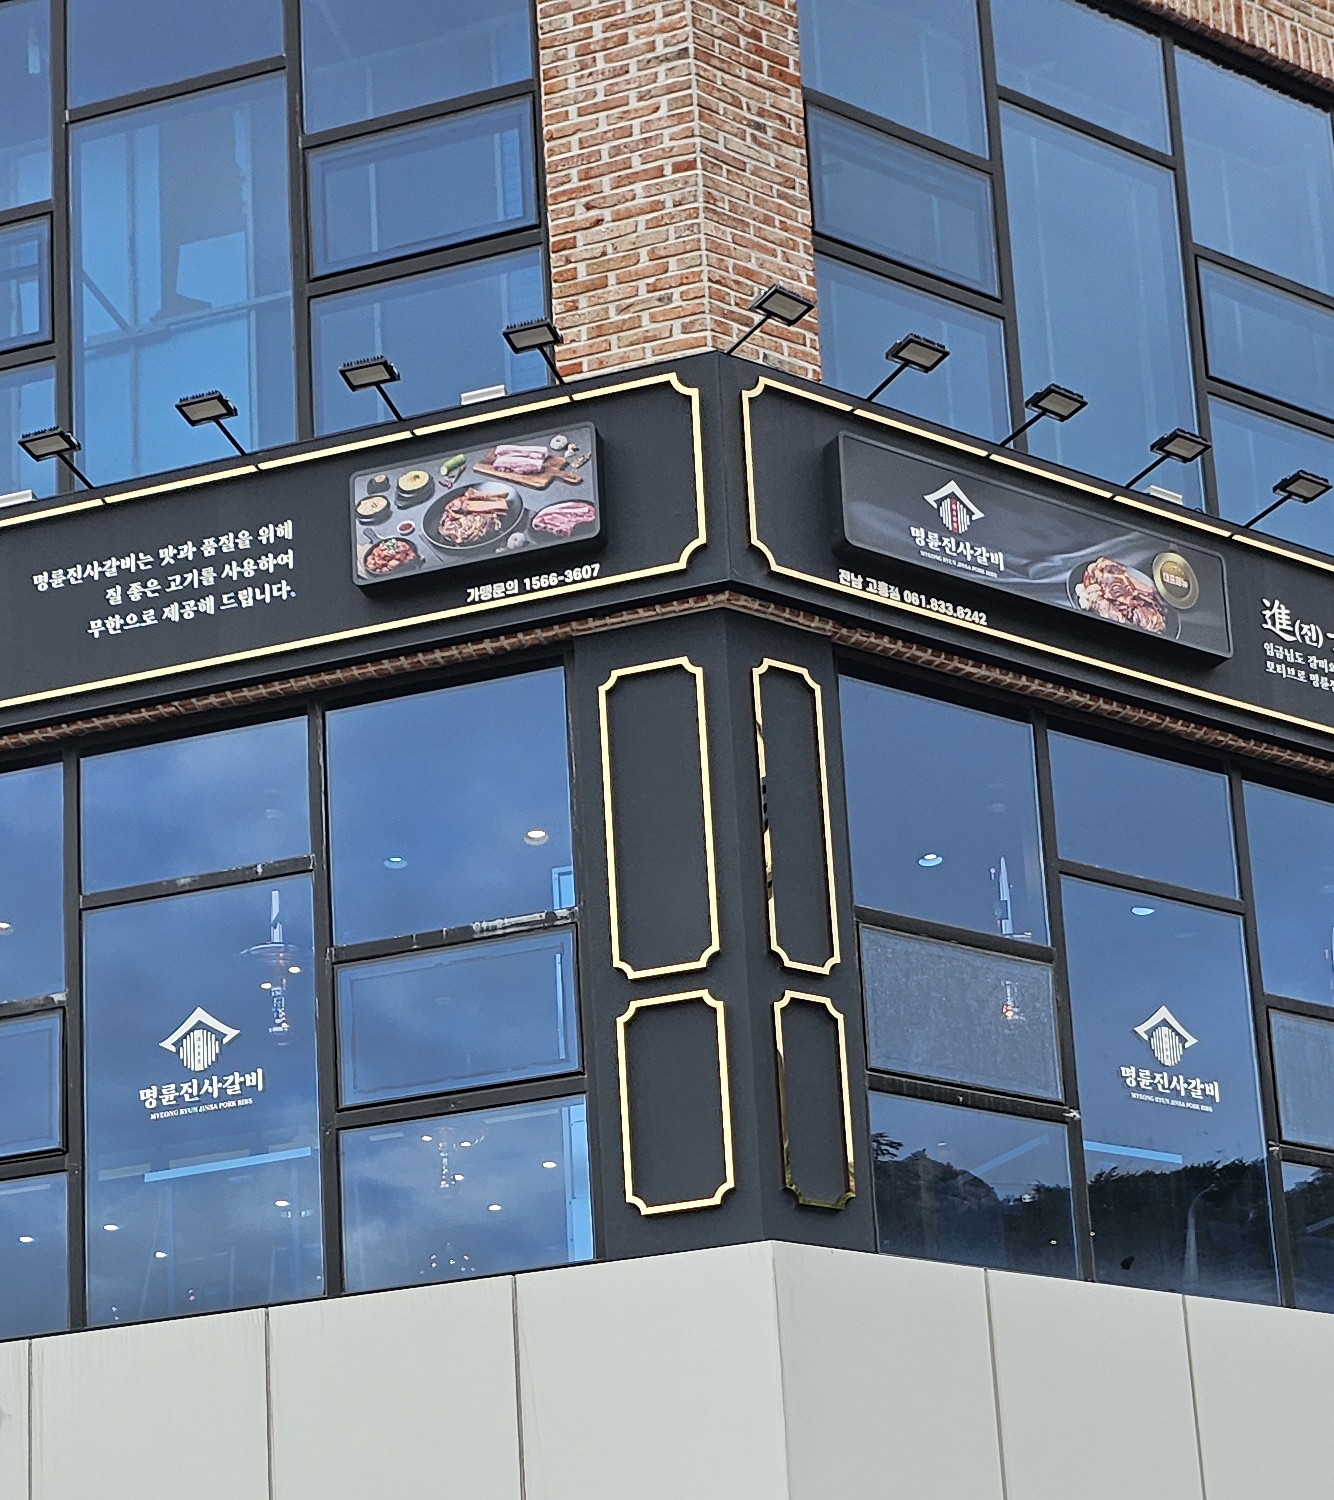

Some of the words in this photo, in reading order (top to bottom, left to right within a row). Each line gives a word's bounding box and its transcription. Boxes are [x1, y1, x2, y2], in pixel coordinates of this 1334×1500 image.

[32, 552, 154, 591] 명륜진사갈비는
[158, 541, 196, 566] 맛과
[199, 530, 253, 557] 품질을
[258, 520, 293, 545] 위해
[909, 525, 1005, 571] 명륜진사갈비
[105, 585, 122, 606] 질
[126, 578, 161, 601] 좋은
[165, 567, 217, 593] 고기를
[221, 549, 294, 581] 사용하여
[466, 579, 519, 602] 가맹문의
[523, 563, 601, 590] 1566-3607
[838, 569, 863, 590] 전남
[865, 577, 901, 601] 고흥점
[87, 609, 158, 638] 무한으로
[161, 595, 215, 622] 제공해
[219, 580, 296, 611] 드립니다.
[1263, 641, 1306, 665] 임금님도
[1265, 661, 1308, 683] 모티브로
[139, 1067, 264, 1109] 명륜진사갈비
[1120, 1065, 1220, 1103] 명륜진사갈비
